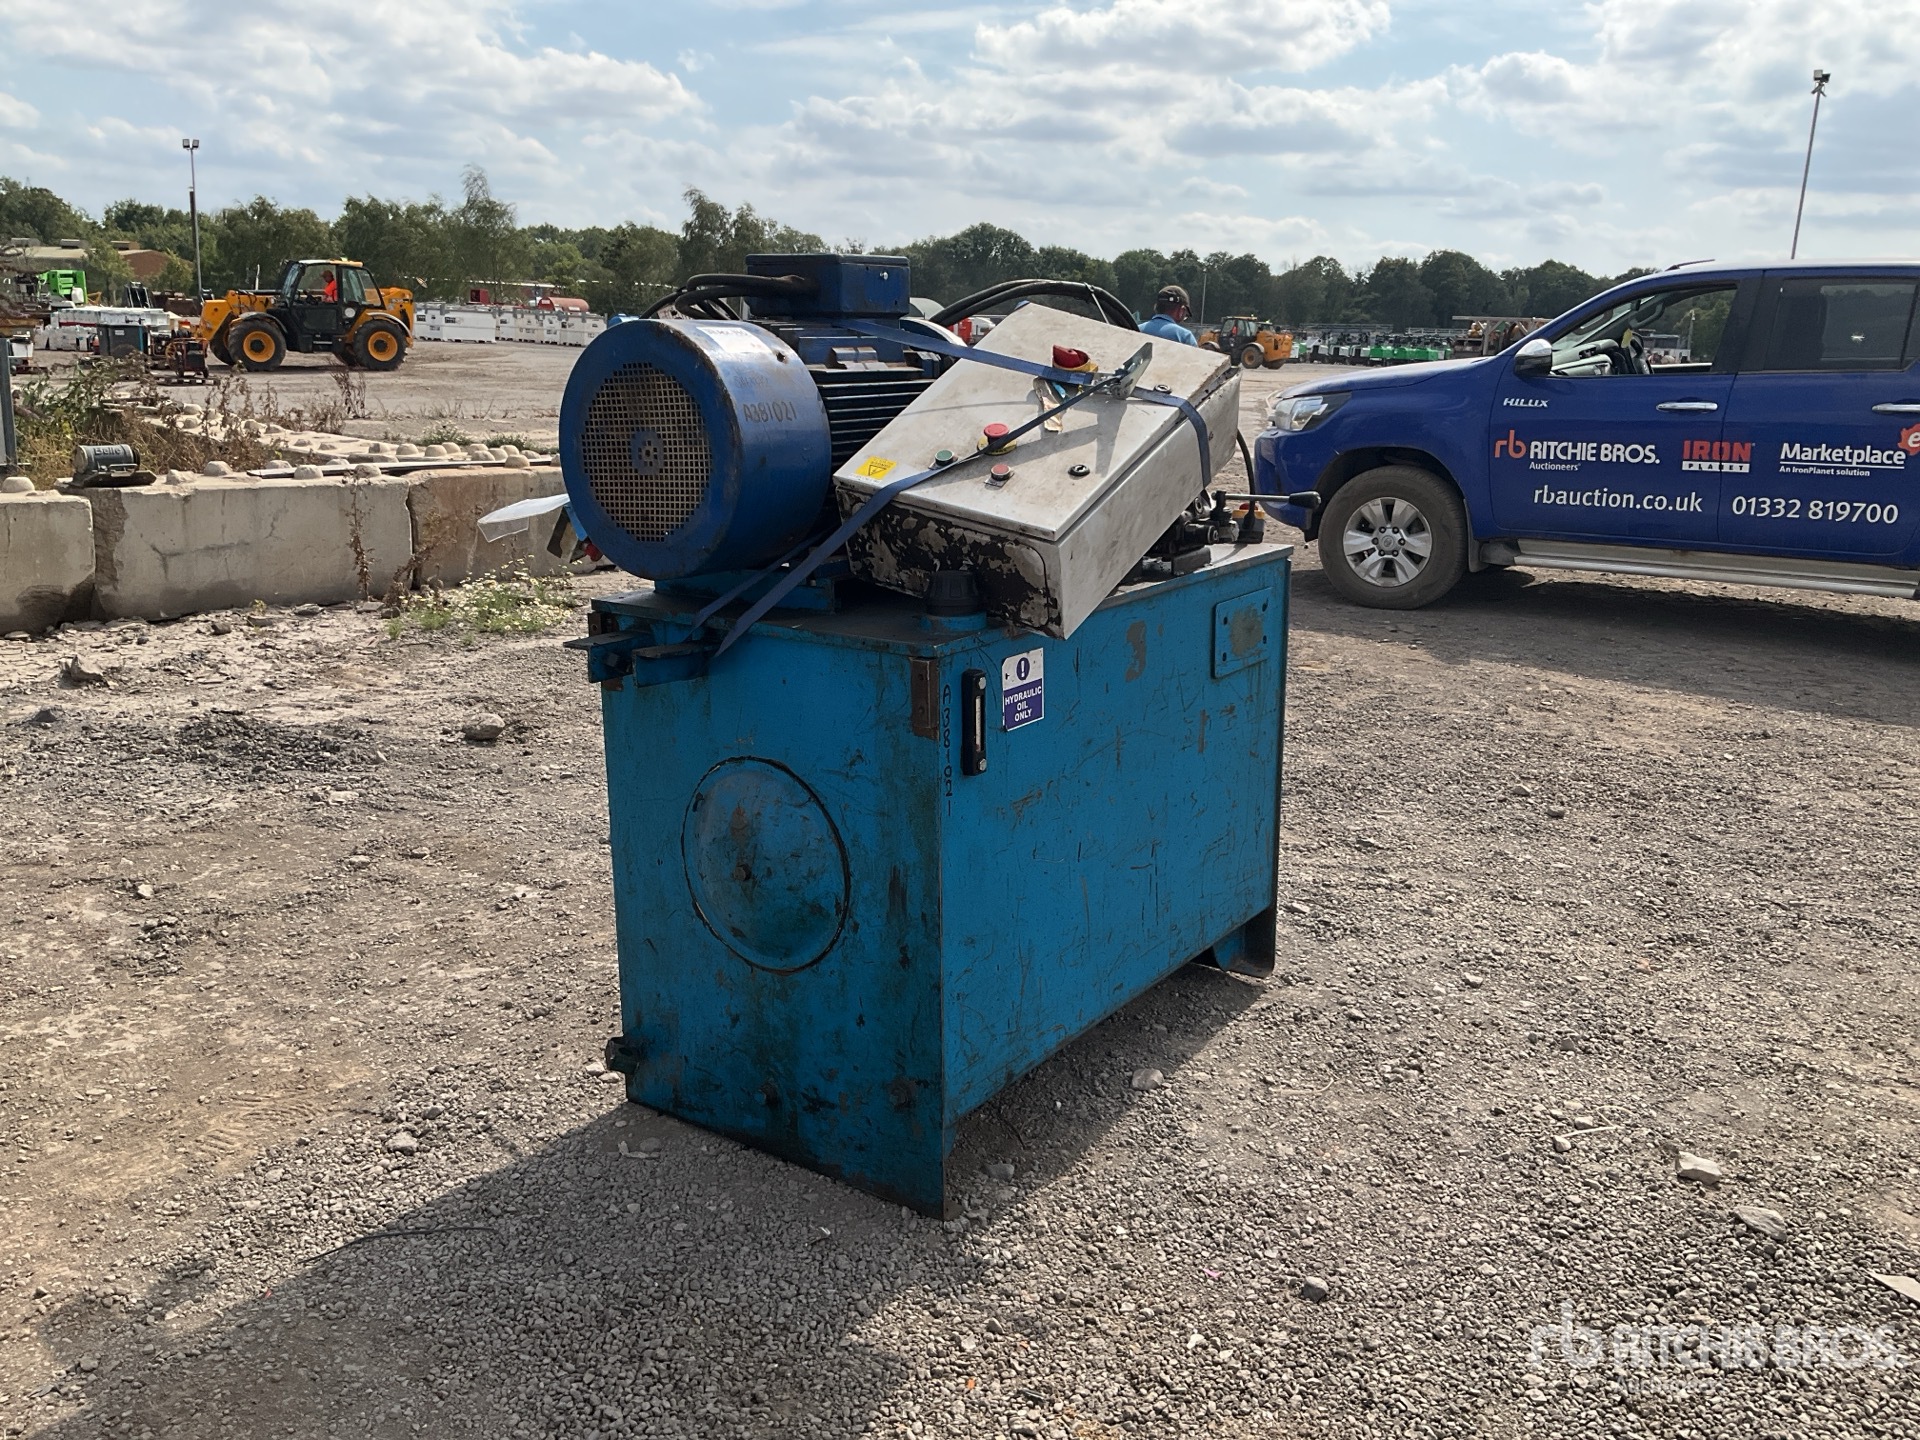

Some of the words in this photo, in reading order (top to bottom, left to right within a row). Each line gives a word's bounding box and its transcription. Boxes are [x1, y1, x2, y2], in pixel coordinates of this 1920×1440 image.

[742, 401, 797, 423] A381021
[1503, 397, 1549, 408] HILUX
[1494, 429, 1527, 459] rb
[1529, 441, 1597, 462] RITCHIE
[1600, 443, 1661, 465] BROS.
[1682, 440, 1751, 462] IRON
[1780, 442, 1906, 466] Marketplace
[1529, 461, 1579, 472] Auctioneers
[1779, 465, 1791, 473] An
[1792, 465, 1834, 476] IronPlanet
[1836, 468, 1870, 477] solution
[1533, 484, 1703, 513] rbauction.co.uk
[1732, 496, 1801, 518] 01332
[1808, 500, 1898, 524] 819700
[1004, 686, 1042, 705] HYDRAULIC
[1016, 700, 1028, 711] OIL
[1014, 708, 1032, 722] ONLY
